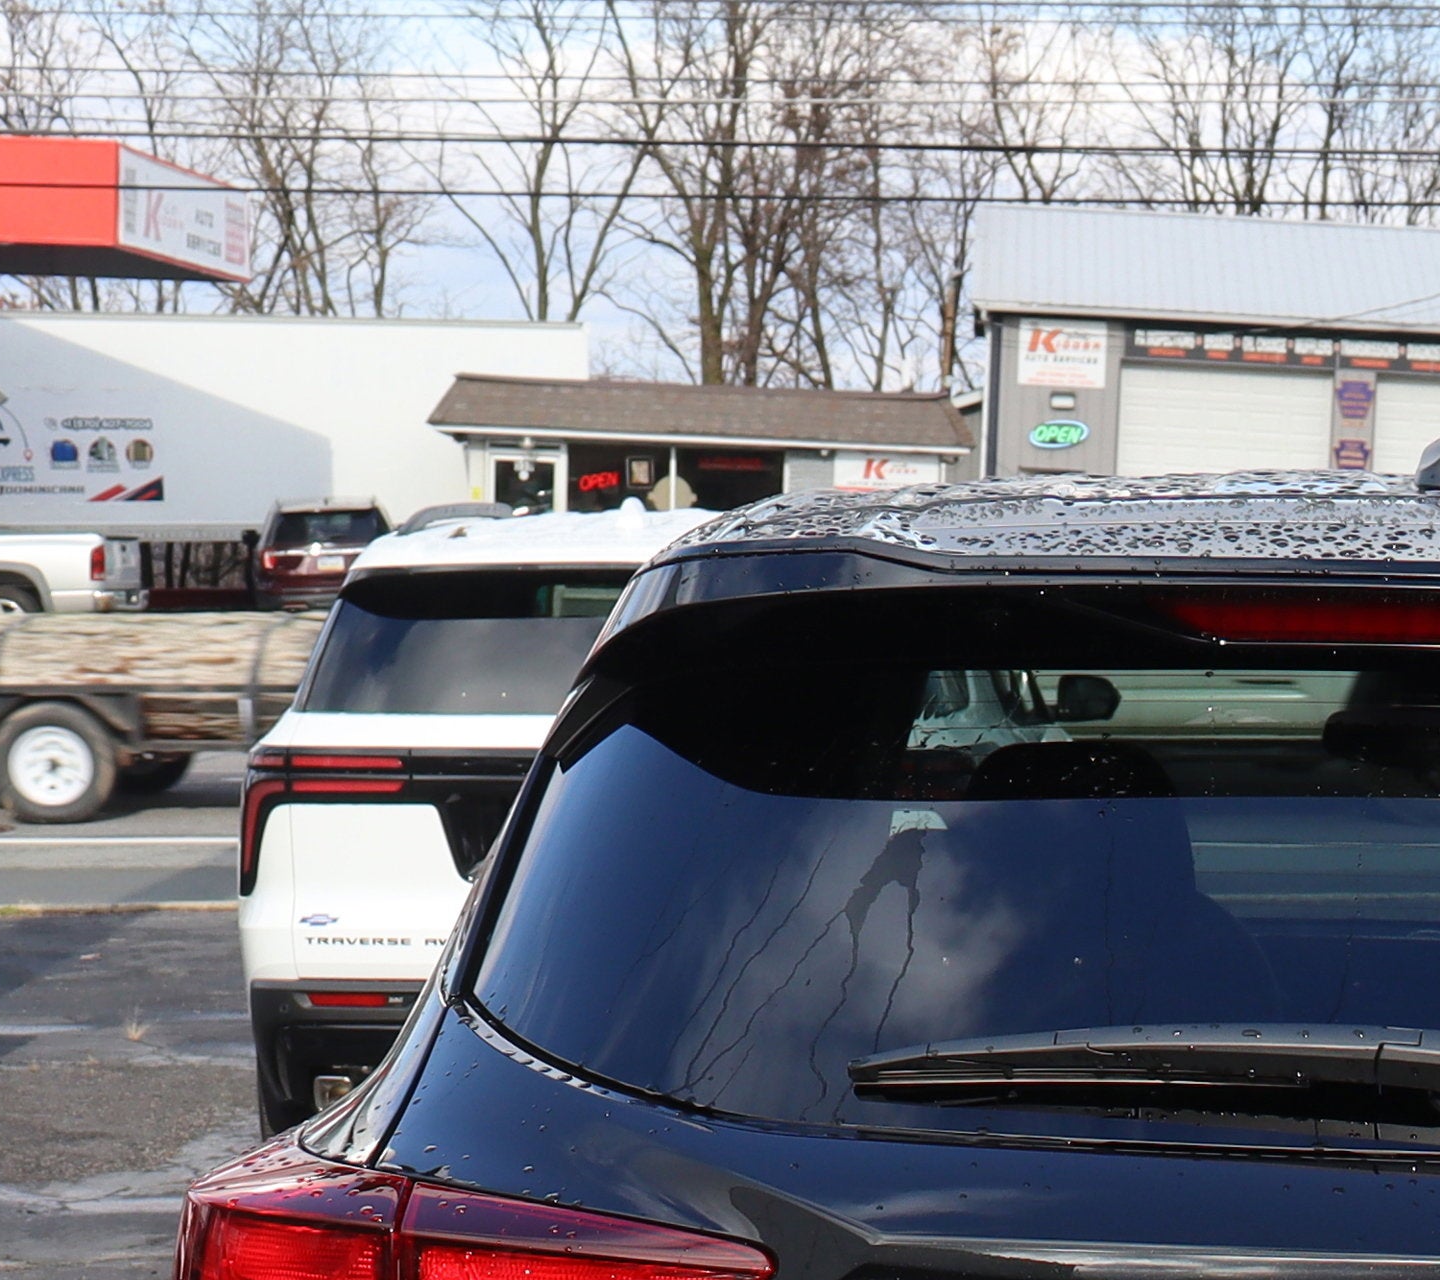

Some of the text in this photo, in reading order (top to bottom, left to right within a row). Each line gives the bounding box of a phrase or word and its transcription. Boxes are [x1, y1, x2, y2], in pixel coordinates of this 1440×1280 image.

[1034, 424, 1081, 444] OPEN
[578, 472, 621, 492] OPEN
[305, 936, 412, 946] TRAVERSE
